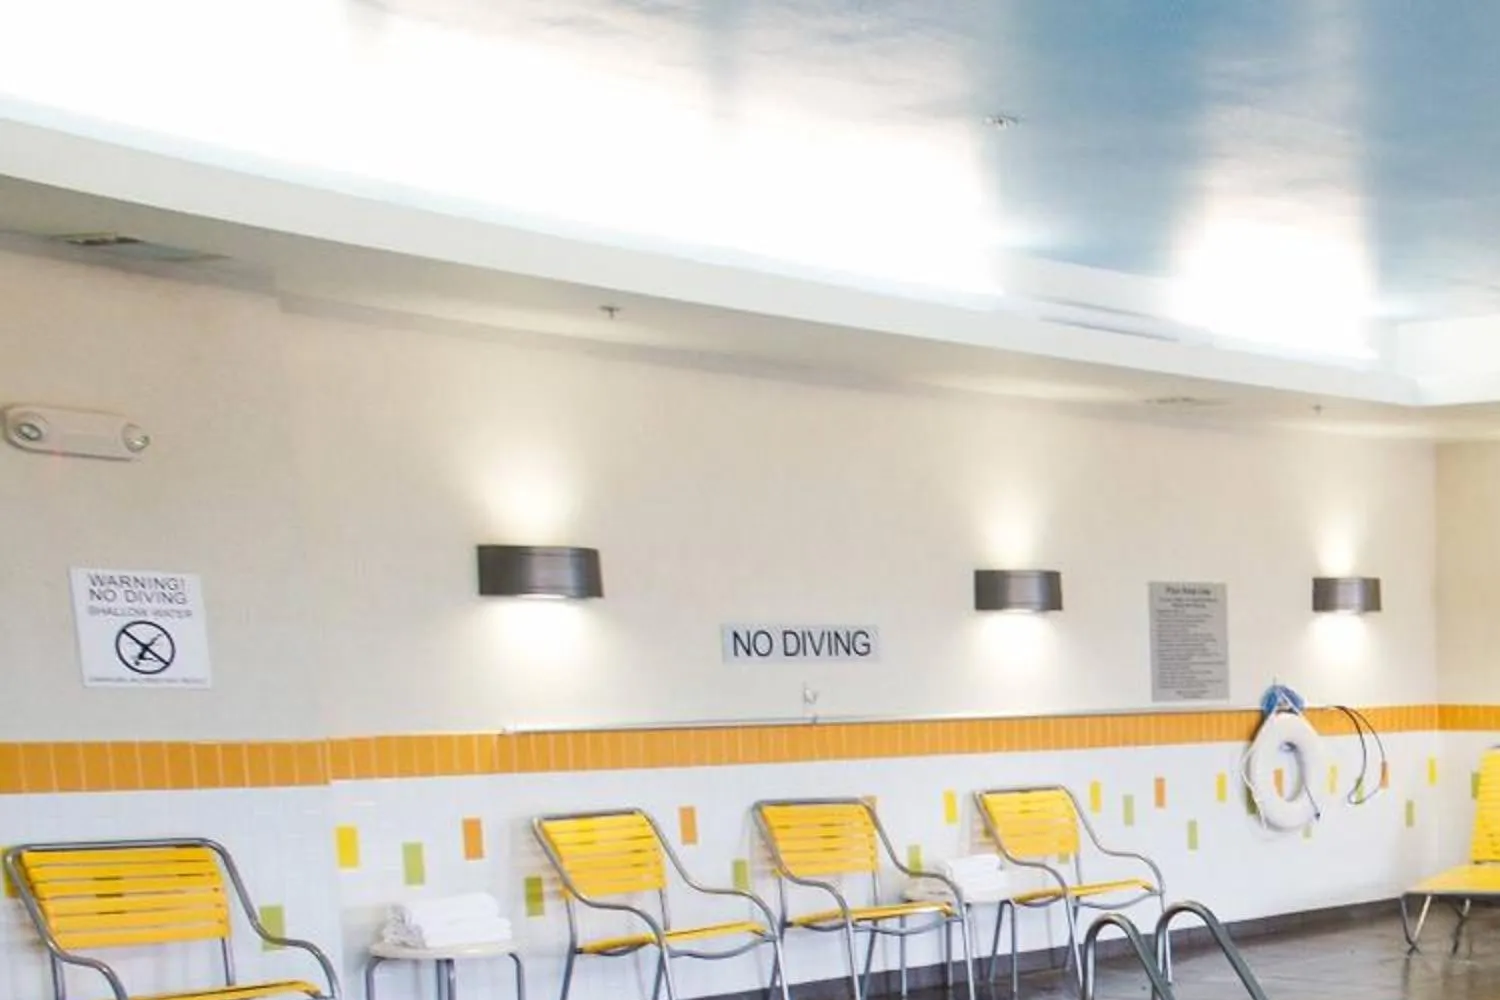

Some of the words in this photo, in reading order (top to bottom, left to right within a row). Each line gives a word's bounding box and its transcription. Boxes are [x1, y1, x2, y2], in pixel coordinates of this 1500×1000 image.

[89, 589, 117, 602] NO
[125, 590, 187, 605] DIVING
[733, 630, 773, 657] NO
[782, 630, 871, 657] DIVING
